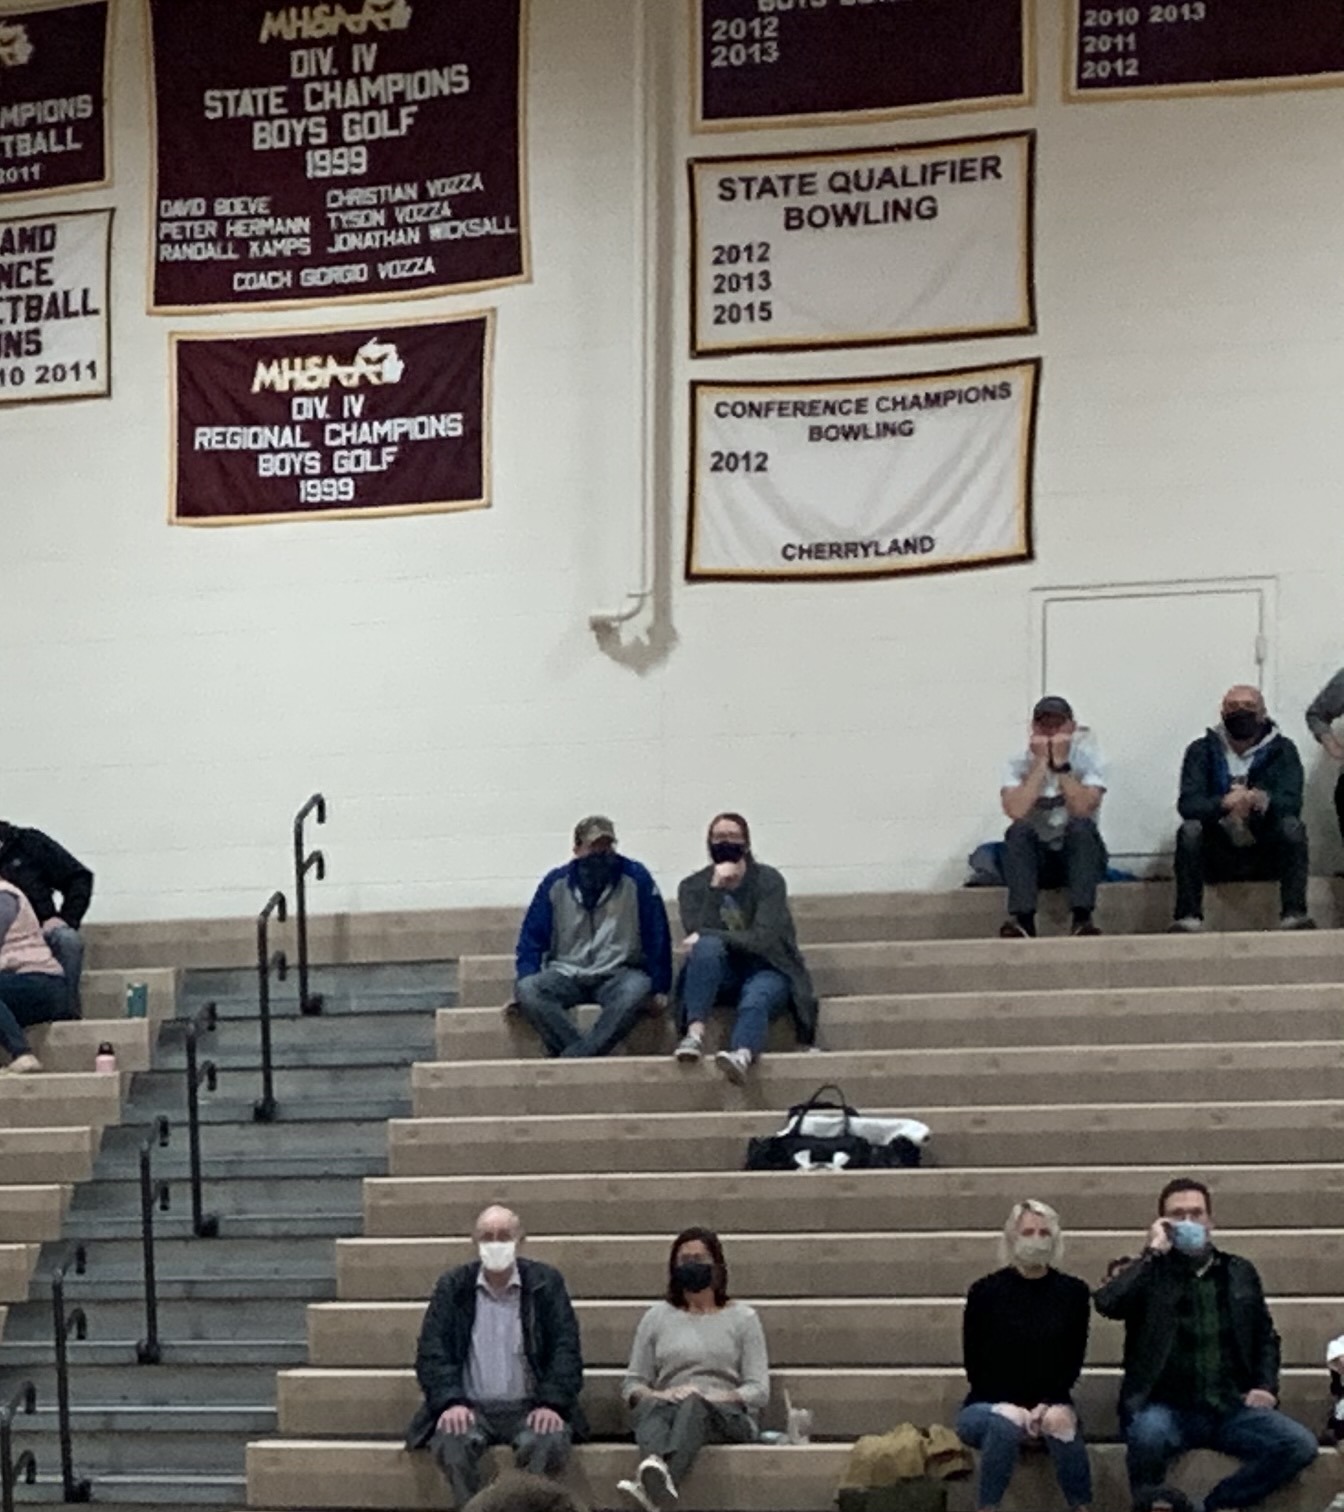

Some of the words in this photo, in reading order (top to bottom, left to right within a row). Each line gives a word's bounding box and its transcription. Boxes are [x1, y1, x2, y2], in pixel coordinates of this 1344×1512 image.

[1083, 7, 1140, 26] 2010
[1148, 2, 1206, 23] 2013
[712, 16, 779, 41] 2012
[711, 41, 780, 67] 2013
[1082, 33, 1137, 53] 2011
[290, 46, 338, 78] DIV.
[352, 42, 378, 74] IV
[1081, 58, 1139, 79] 2012
[204, 86, 288, 119] STATE
[304, 64, 470, 112] CHAMPIONS
[253, 117, 328, 150] BOYS
[342, 106, 418, 142] GOLF
[306, 146, 368, 178] 1999
[326, 183, 418, 208] CHRISTIAN
[426, 172, 484, 198] VOZZA
[717, 171, 818, 202] STATE
[828, 155, 1003, 194] QUALIFIER
[160, 198, 206, 217] DAVID
[326, 209, 385, 230] TYSON
[394, 201, 451, 223] VOZZA
[783, 195, 939, 232] BOWLING
[160, 219, 217, 240] PETER
[226, 216, 311, 237] HERMANN
[327, 227, 420, 253] JONATHAN
[160, 241, 239, 262] RANDALL
[711, 241, 771, 266] 2012
[233, 271, 292, 291] COACH
[378, 257, 436, 280] VOZZA
[713, 270, 772, 294] 2013
[713, 301, 773, 325] 2015
[35, 360, 97, 385] 2011
[343, 394, 365, 418] IV
[714, 396, 869, 419] CONFERENCE
[875, 381, 1013, 412] CHAMPIONS
[194, 426, 311, 450] REGIONAL
[324, 413, 463, 446] CHAMPIONS
[807, 419, 915, 443] BOWLING
[258, 452, 321, 477] BOYS
[333, 447, 398, 474] GOLF
[710, 451, 769, 473] 2012
[299, 477, 355, 503] 1999
[781, 534, 936, 561] CHERRYLAND
